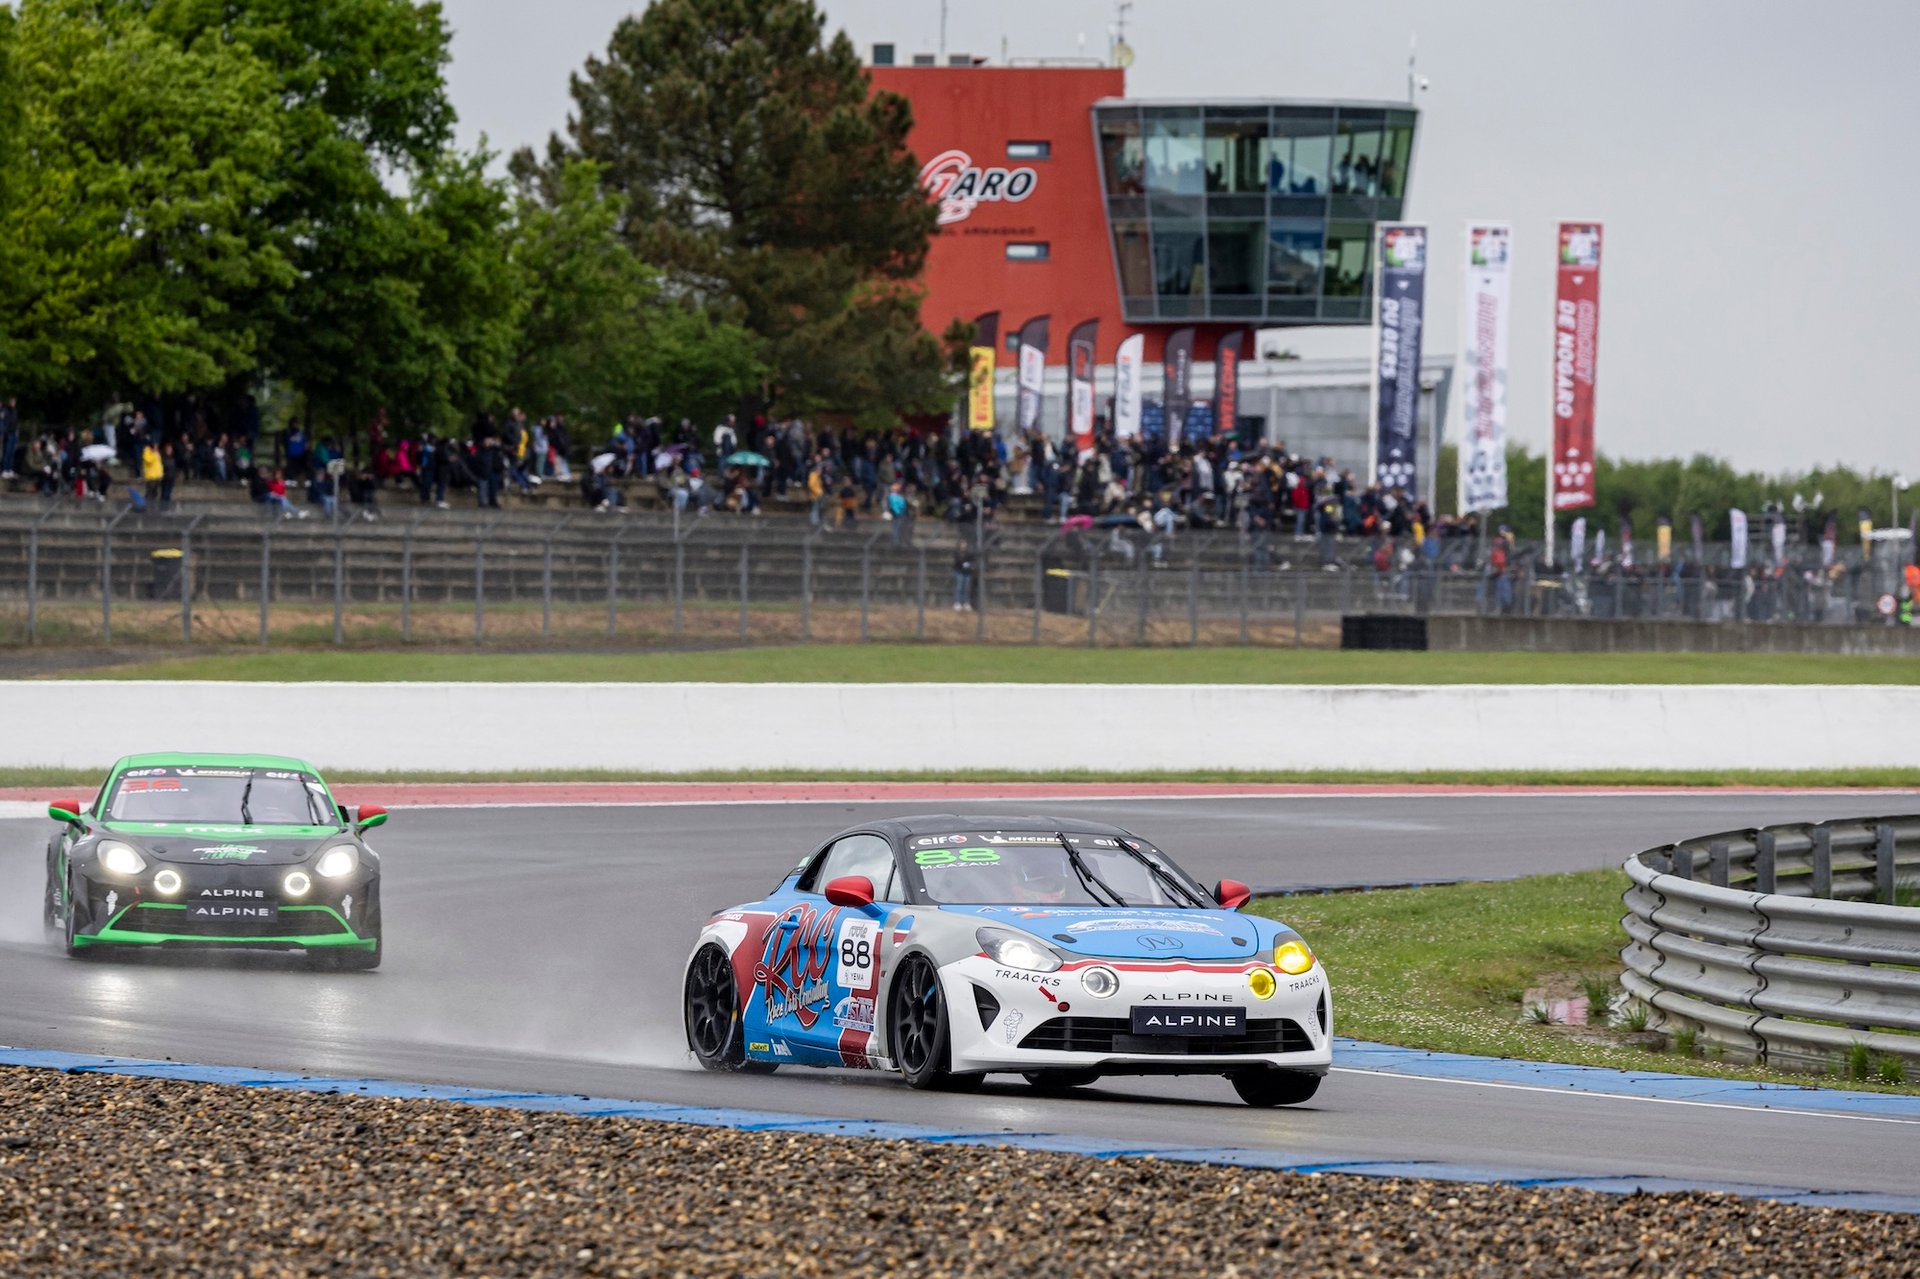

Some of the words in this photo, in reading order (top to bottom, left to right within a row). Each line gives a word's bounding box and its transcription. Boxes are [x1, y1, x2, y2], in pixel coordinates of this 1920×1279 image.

[1382, 298, 1399, 328] DU
[1557, 299, 1576, 330] DE
[1380, 327, 1399, 379] GERS
[1556, 331, 1576, 419] NOGARO
[918, 836, 947, 845] elf
[914, 847, 1001, 865] 88
[200, 889, 264, 897] ALPINE
[196, 907, 269, 916] ALPINE
[842, 938, 871, 969] 88
[850, 972, 864, 982] YEMA
[995, 969, 1062, 987] TRAACKS
[1289, 974, 1320, 993] TRAACKS
[1143, 993, 1233, 1002] ALPINE
[1145, 1015, 1238, 1027] ALPINE
